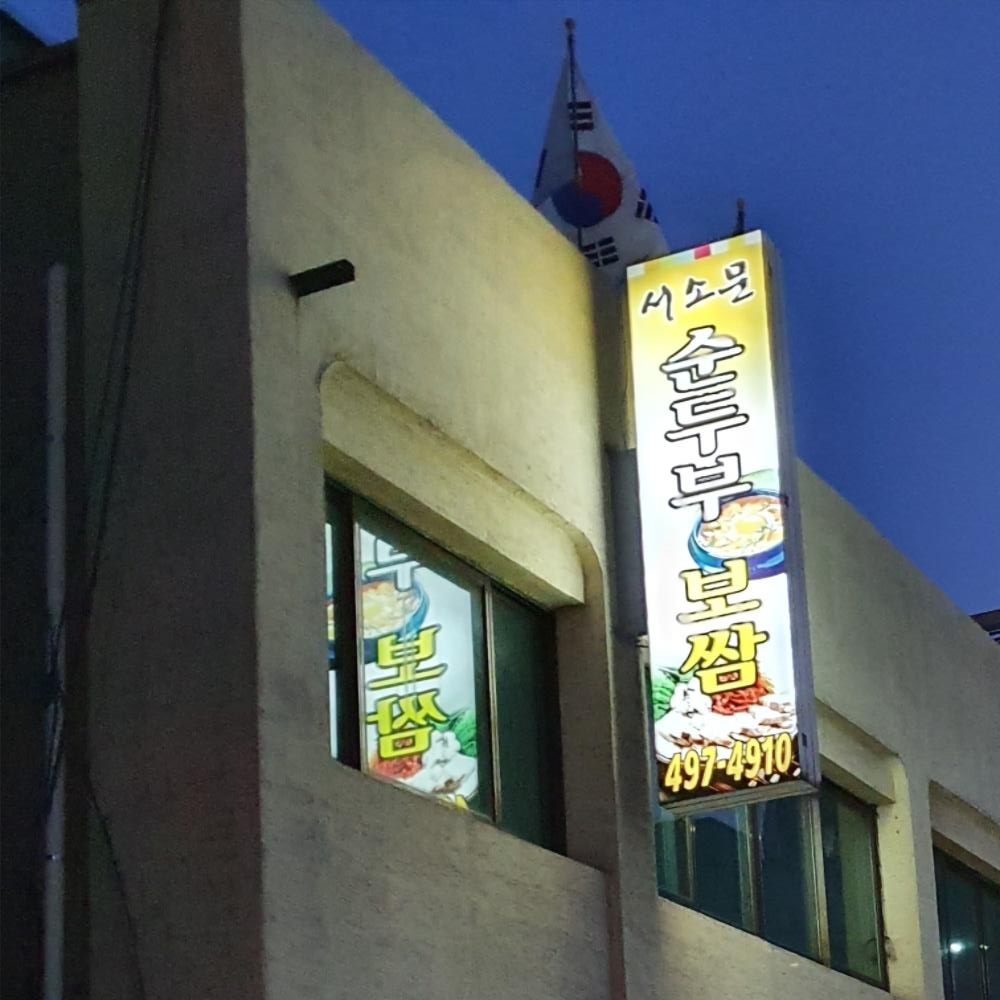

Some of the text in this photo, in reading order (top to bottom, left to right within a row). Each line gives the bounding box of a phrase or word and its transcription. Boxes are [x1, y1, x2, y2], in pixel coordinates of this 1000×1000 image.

[641, 261, 754, 321] 서소문
[659, 324, 770, 695] 순두부 보쌈
[664, 731, 793, 793] 497-4910
